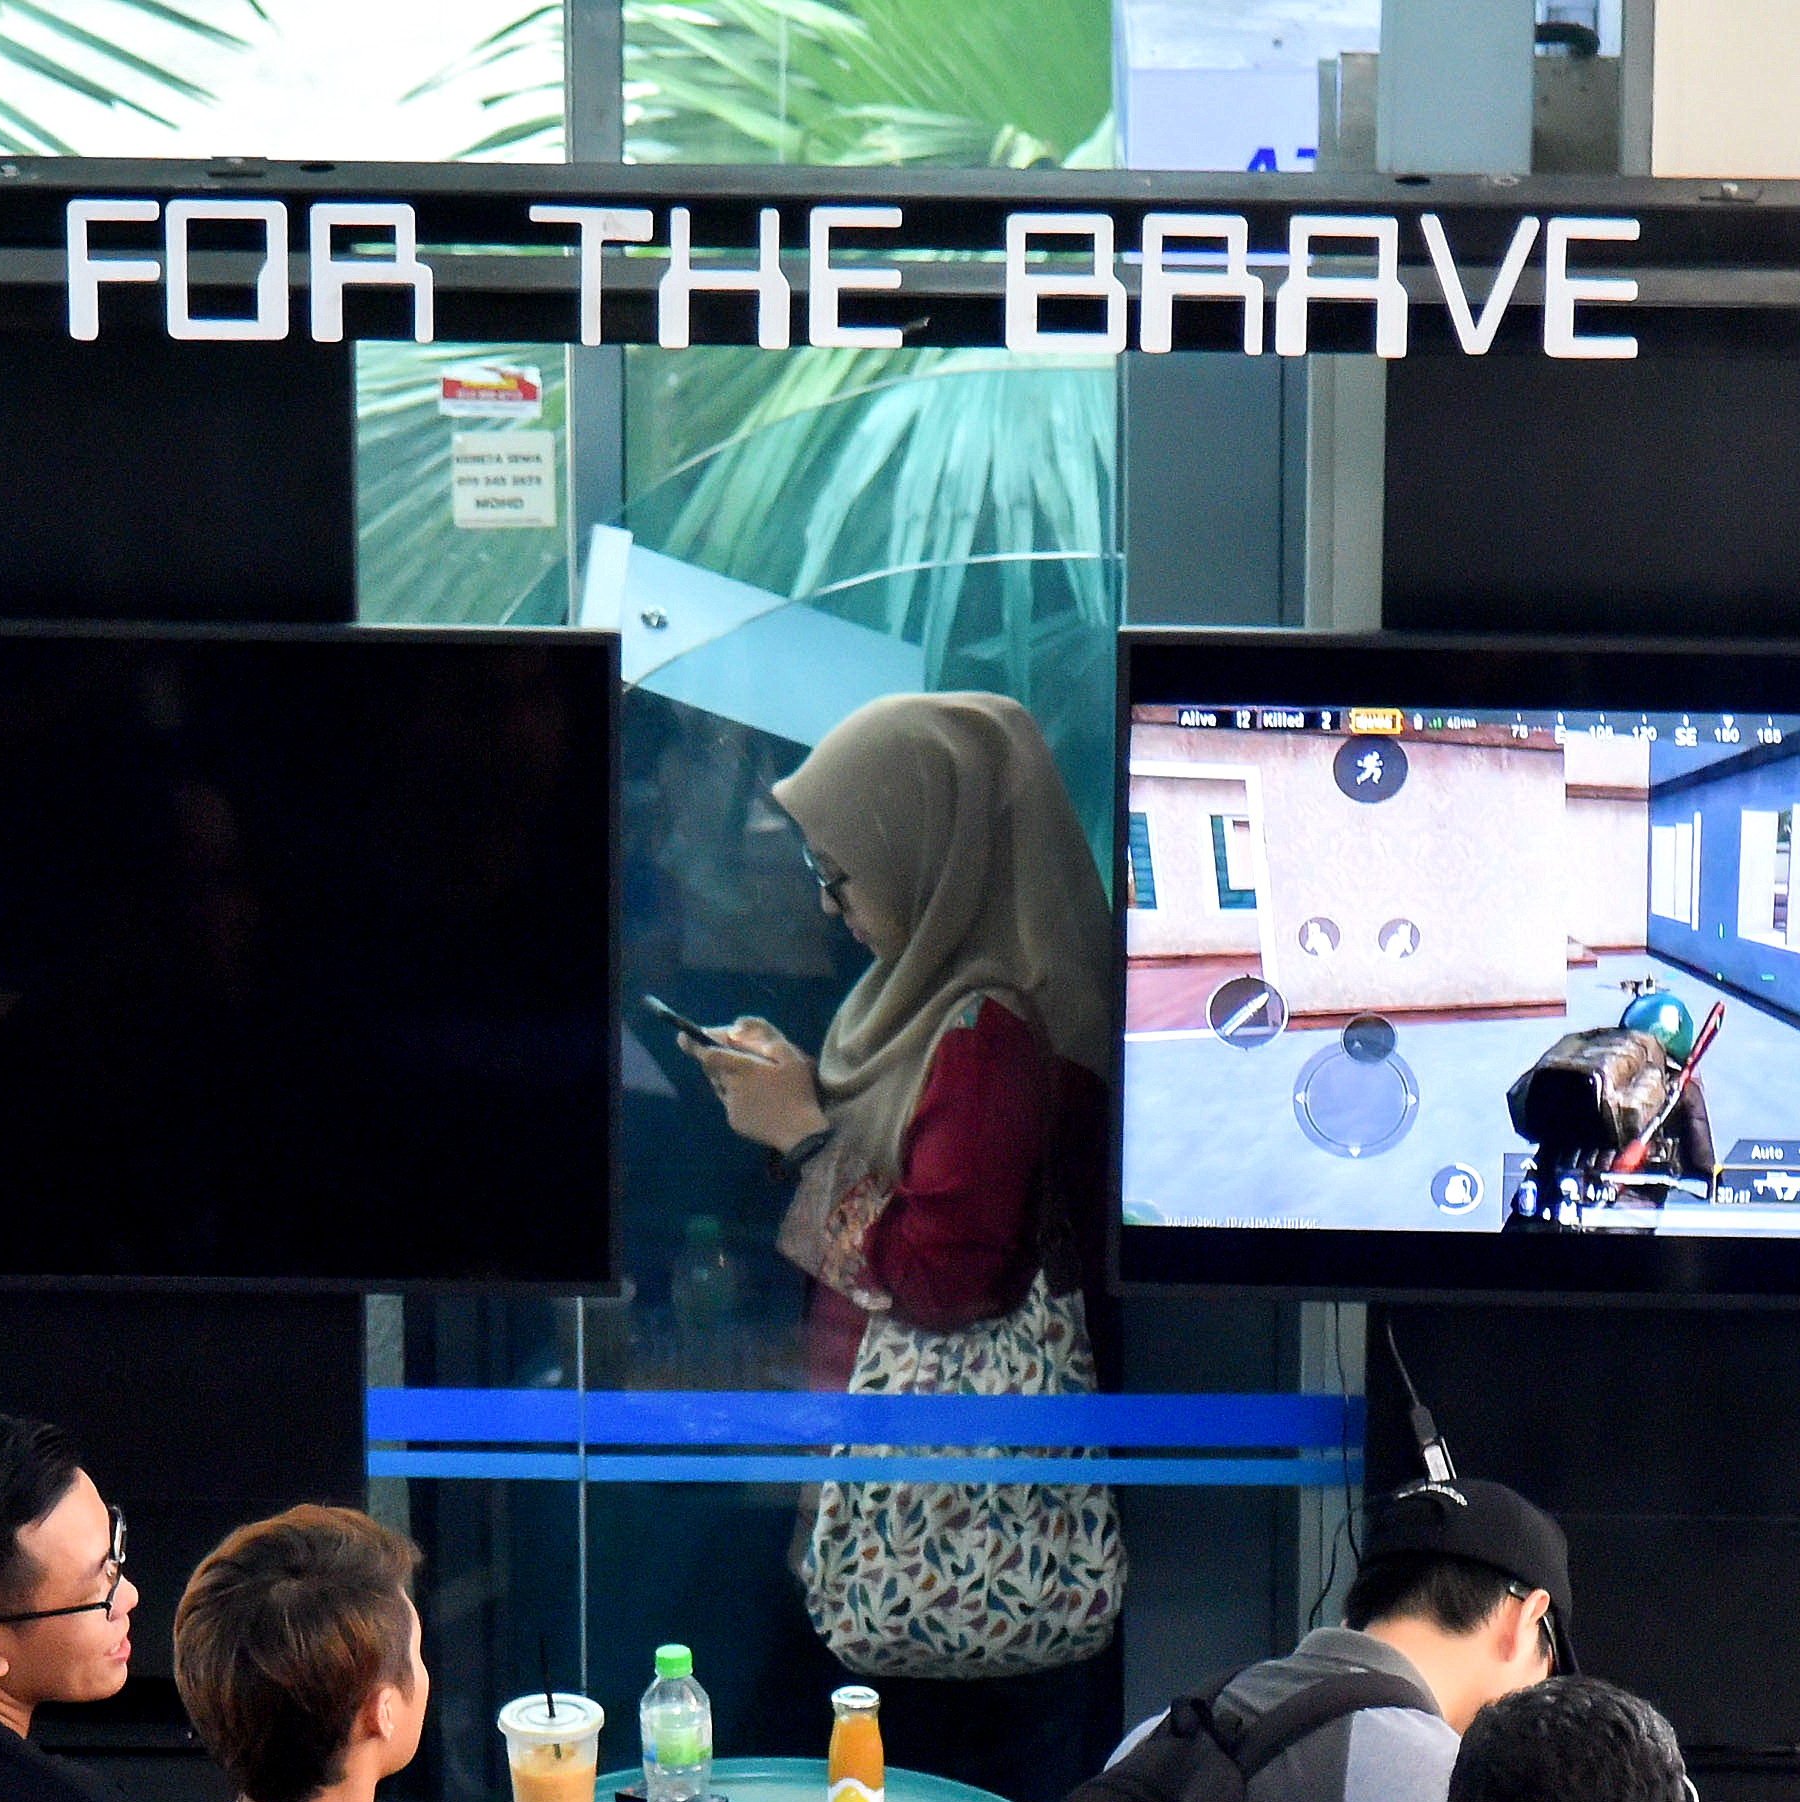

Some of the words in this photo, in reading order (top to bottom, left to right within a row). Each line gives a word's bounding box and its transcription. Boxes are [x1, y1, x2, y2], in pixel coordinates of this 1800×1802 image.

[66, 199, 434, 343] FOR
[529, 204, 905, 350] THE
[1004, 212, 1641, 360] BRAVE
[1179, 711, 1217, 727] Alive
[1236, 710, 1251, 729] 12
[1262, 710, 1305, 729] Killed
[1321, 711, 1332, 729] 2
[1554, 725, 1567, 744] E
[1674, 728, 1698, 747] SE
[1751, 1144, 1784, 1160] Auto
